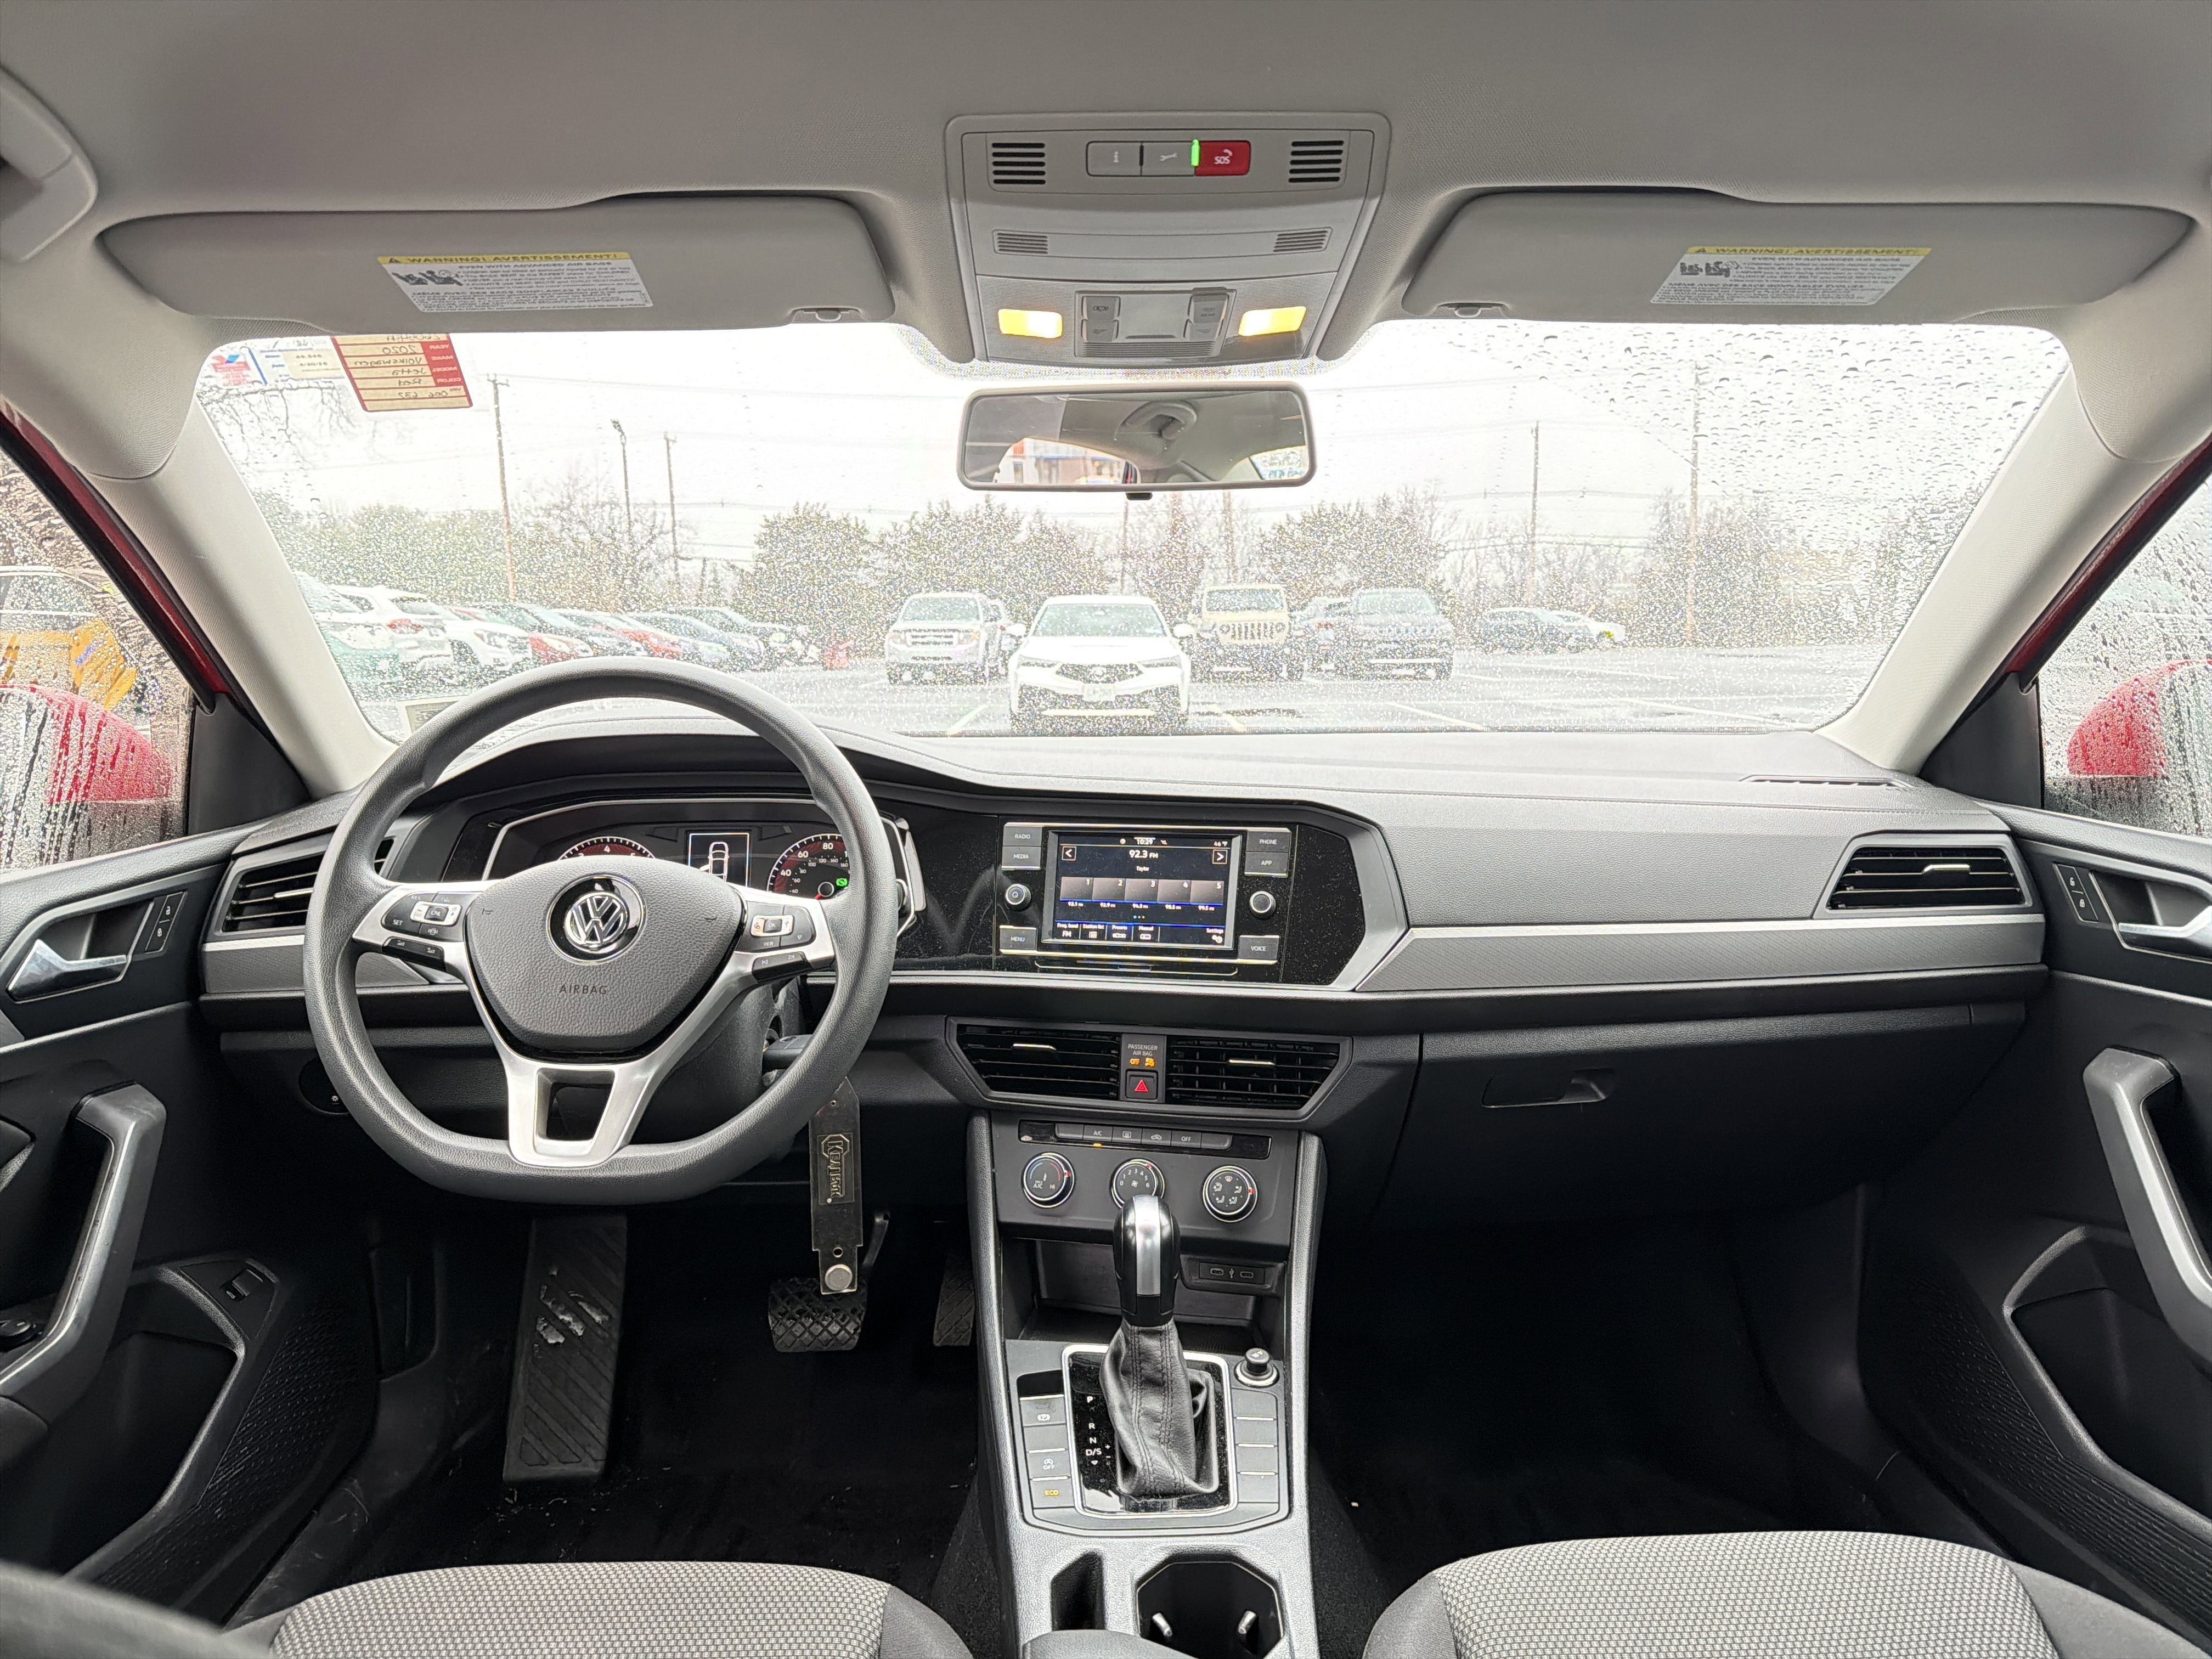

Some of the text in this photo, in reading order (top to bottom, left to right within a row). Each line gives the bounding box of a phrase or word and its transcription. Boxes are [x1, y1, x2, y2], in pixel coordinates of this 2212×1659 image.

[1214, 155, 1231, 165] SOS
[603, 845, 611, 853] 4
[1128, 849, 1148, 859] 92.3
[780, 868, 792, 877] 40
[559, 984, 607, 995] AIRBAG
[1085, 1448, 1102, 1457] D/S
